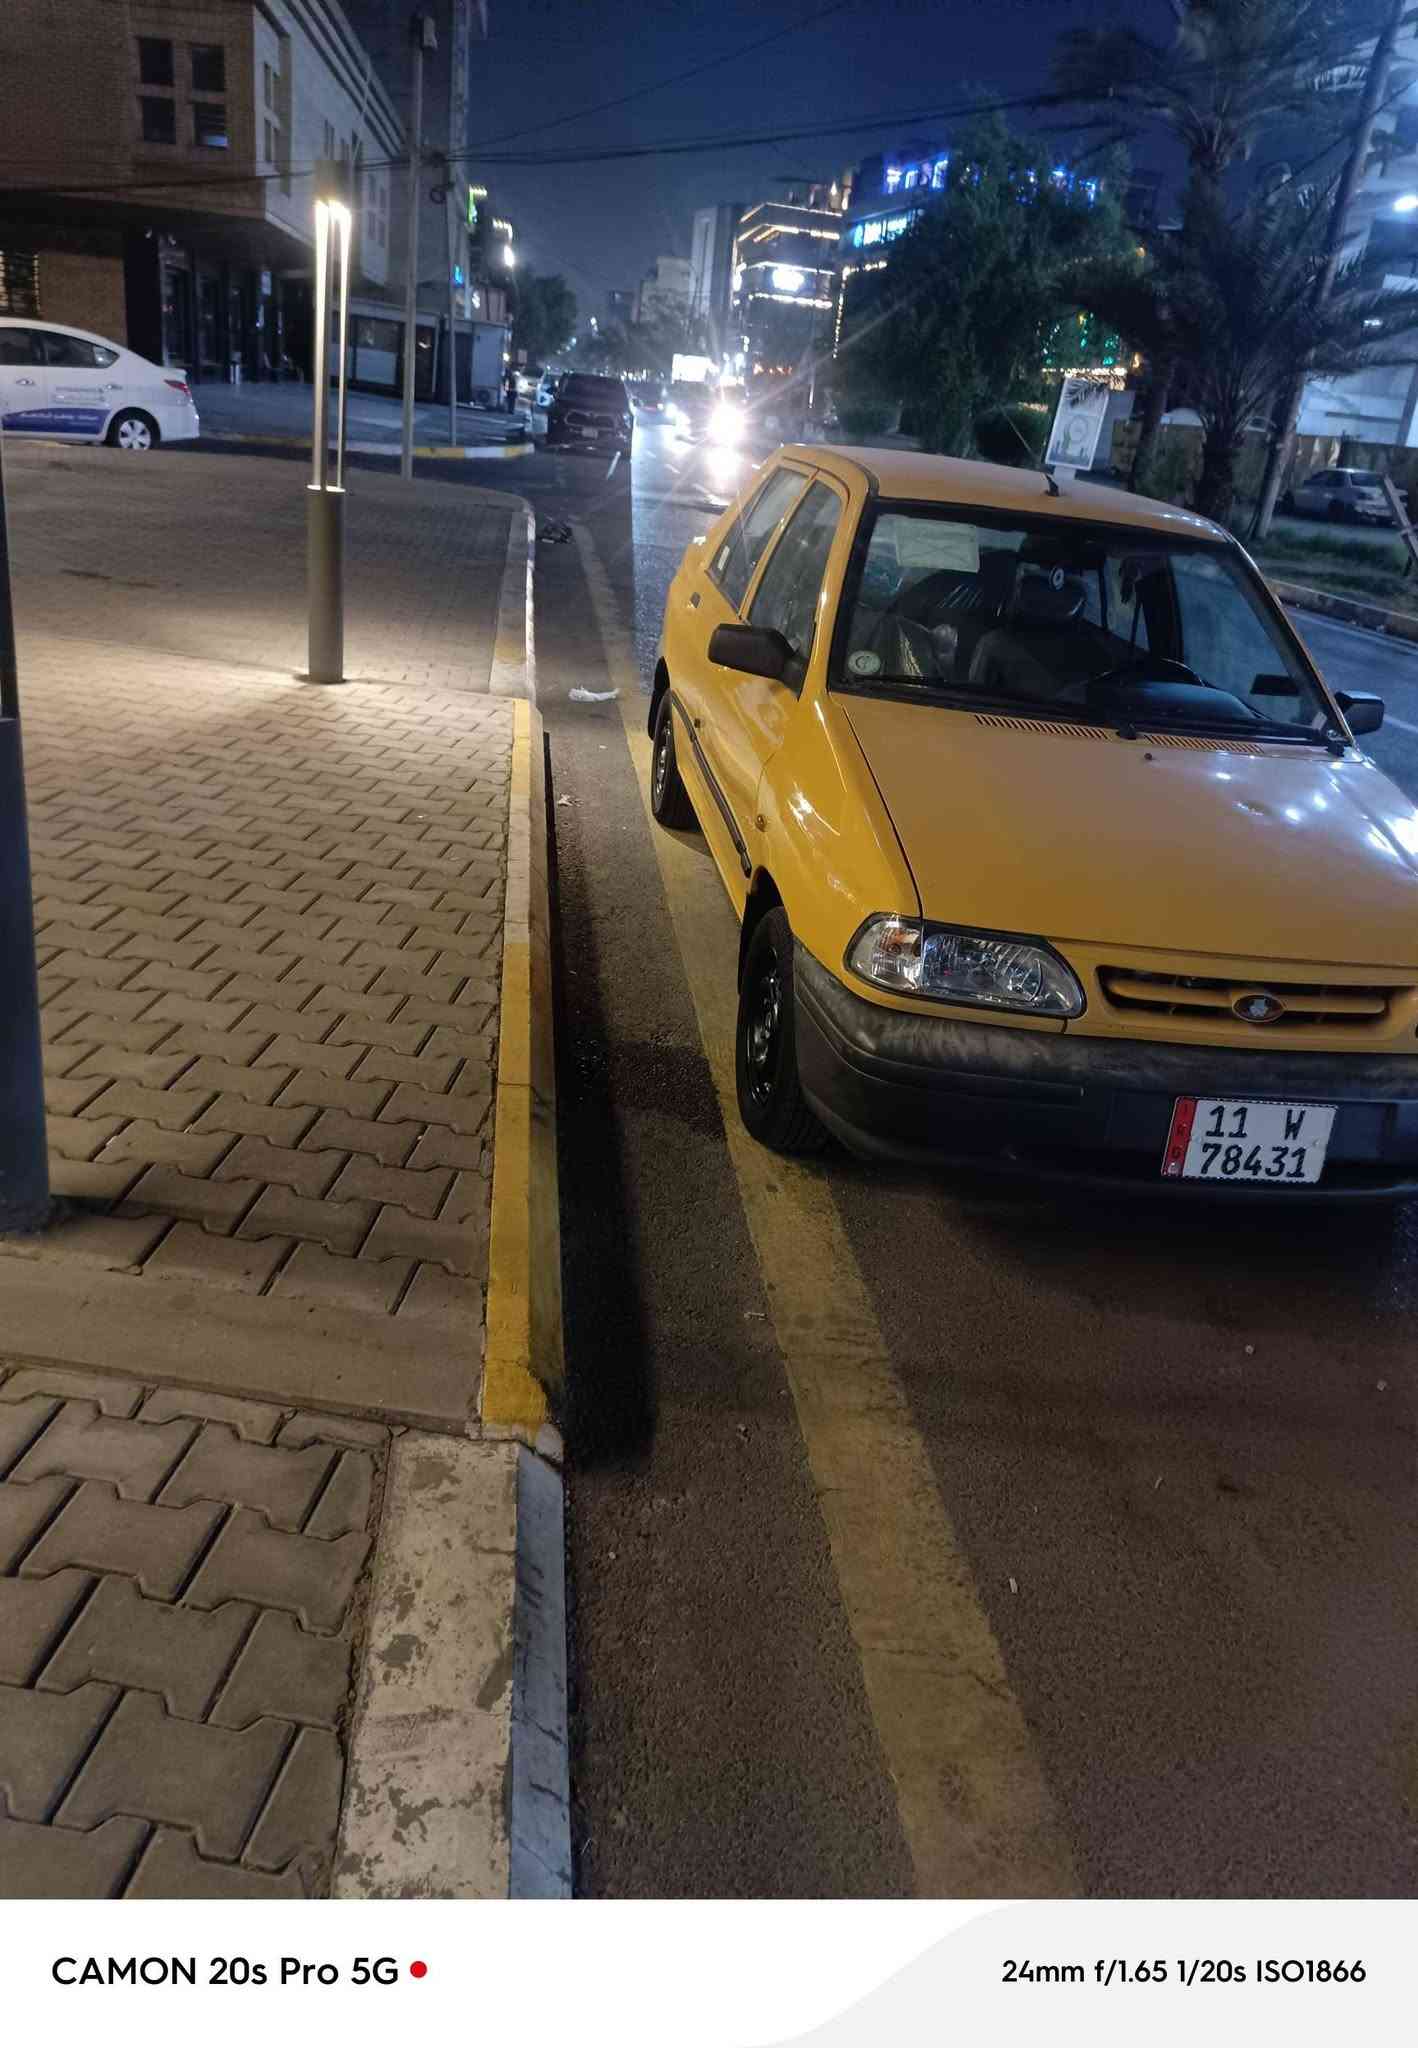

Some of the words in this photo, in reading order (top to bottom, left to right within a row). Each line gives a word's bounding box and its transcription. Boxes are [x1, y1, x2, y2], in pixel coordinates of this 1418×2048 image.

[1205, 1105, 1248, 1138] 11
[1284, 1109, 1306, 1141] W
[1201, 1142, 1307, 1178] 78431
